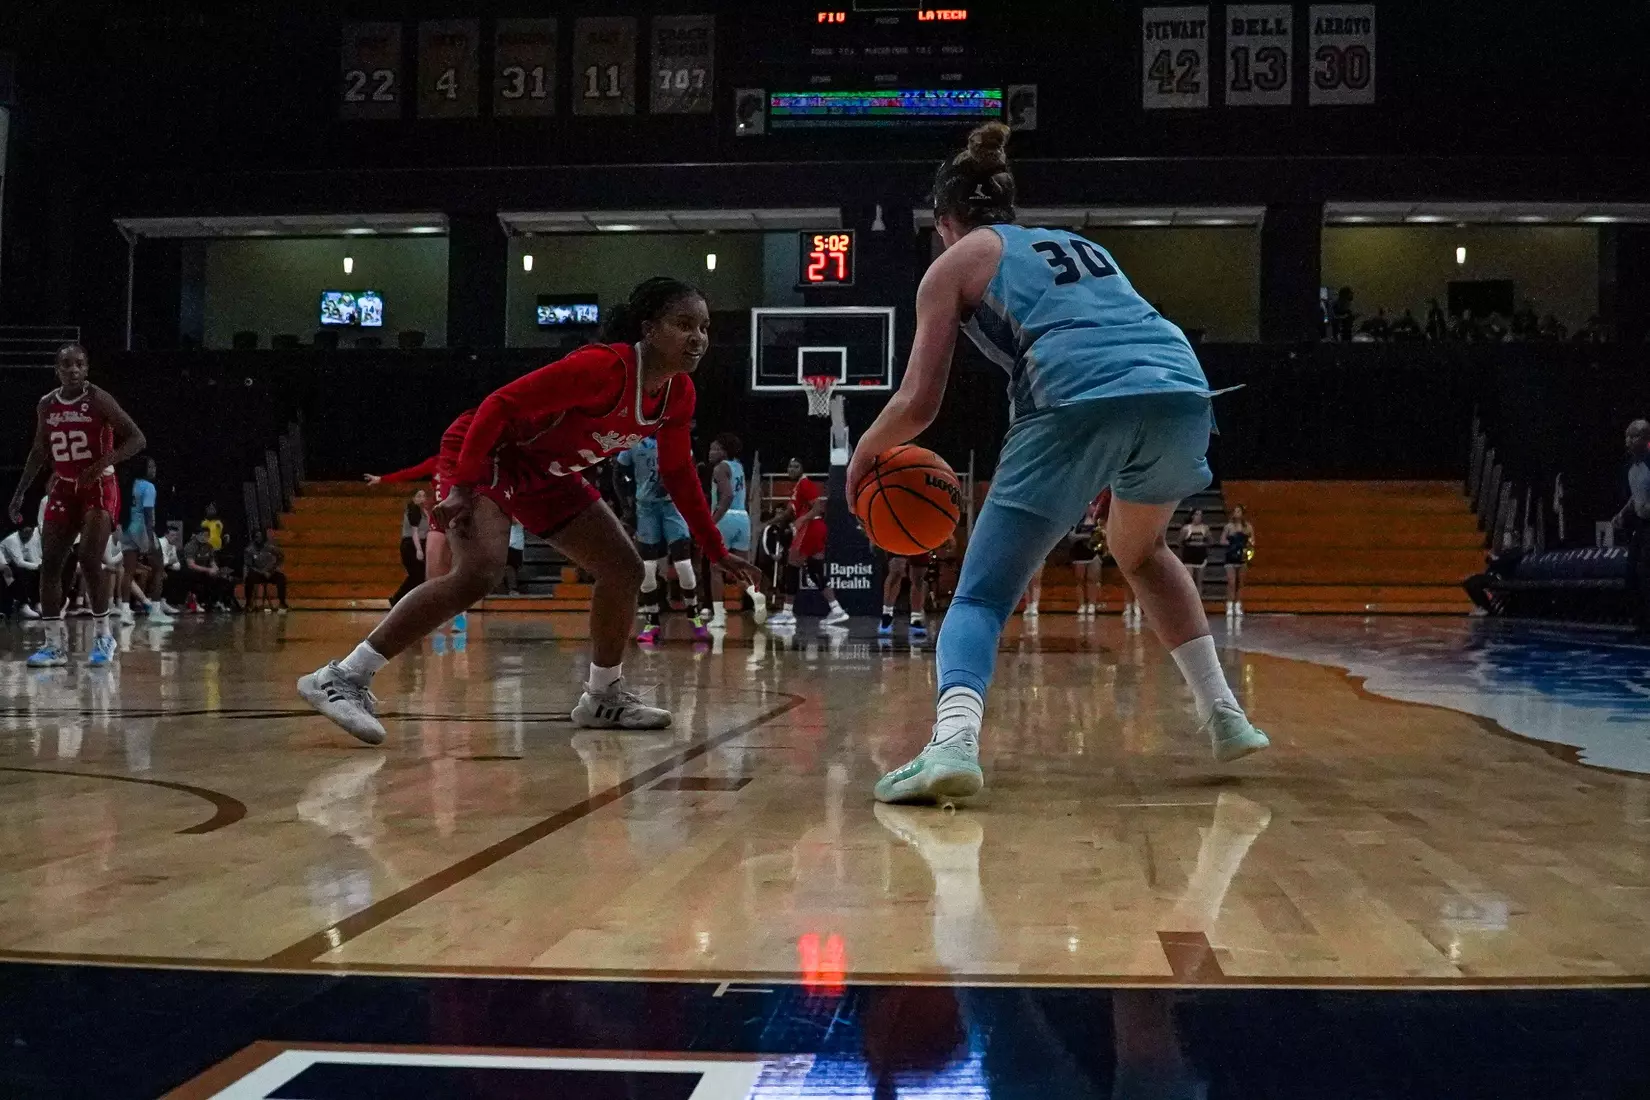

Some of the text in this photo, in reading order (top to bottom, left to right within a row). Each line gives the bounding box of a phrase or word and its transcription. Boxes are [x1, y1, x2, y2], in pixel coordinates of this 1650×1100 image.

[817, 11, 846, 23] FIU
[1146, 20, 1206, 39] STEWART
[1230, 18, 1287, 35] BELL
[1314, 18, 1371, 35] ARROYO
[501, 66, 547, 98] 31
[584, 65, 621, 97] 11
[659, 69, 706, 89] 707
[1148, 49, 1200, 94] 42
[1230, 46, 1287, 91] 13
[1313, 45, 1371, 90] 30
[344, 69, 395, 101] 22
[436, 68, 459, 100] 4
[813, 234, 850, 251] 5:02
[807, 252, 845, 281] 27
[1031, 238, 1118, 286] 30
[50, 430, 93, 462] 22
[829, 562, 873, 578] Baptist
[829, 576, 871, 590] Health
